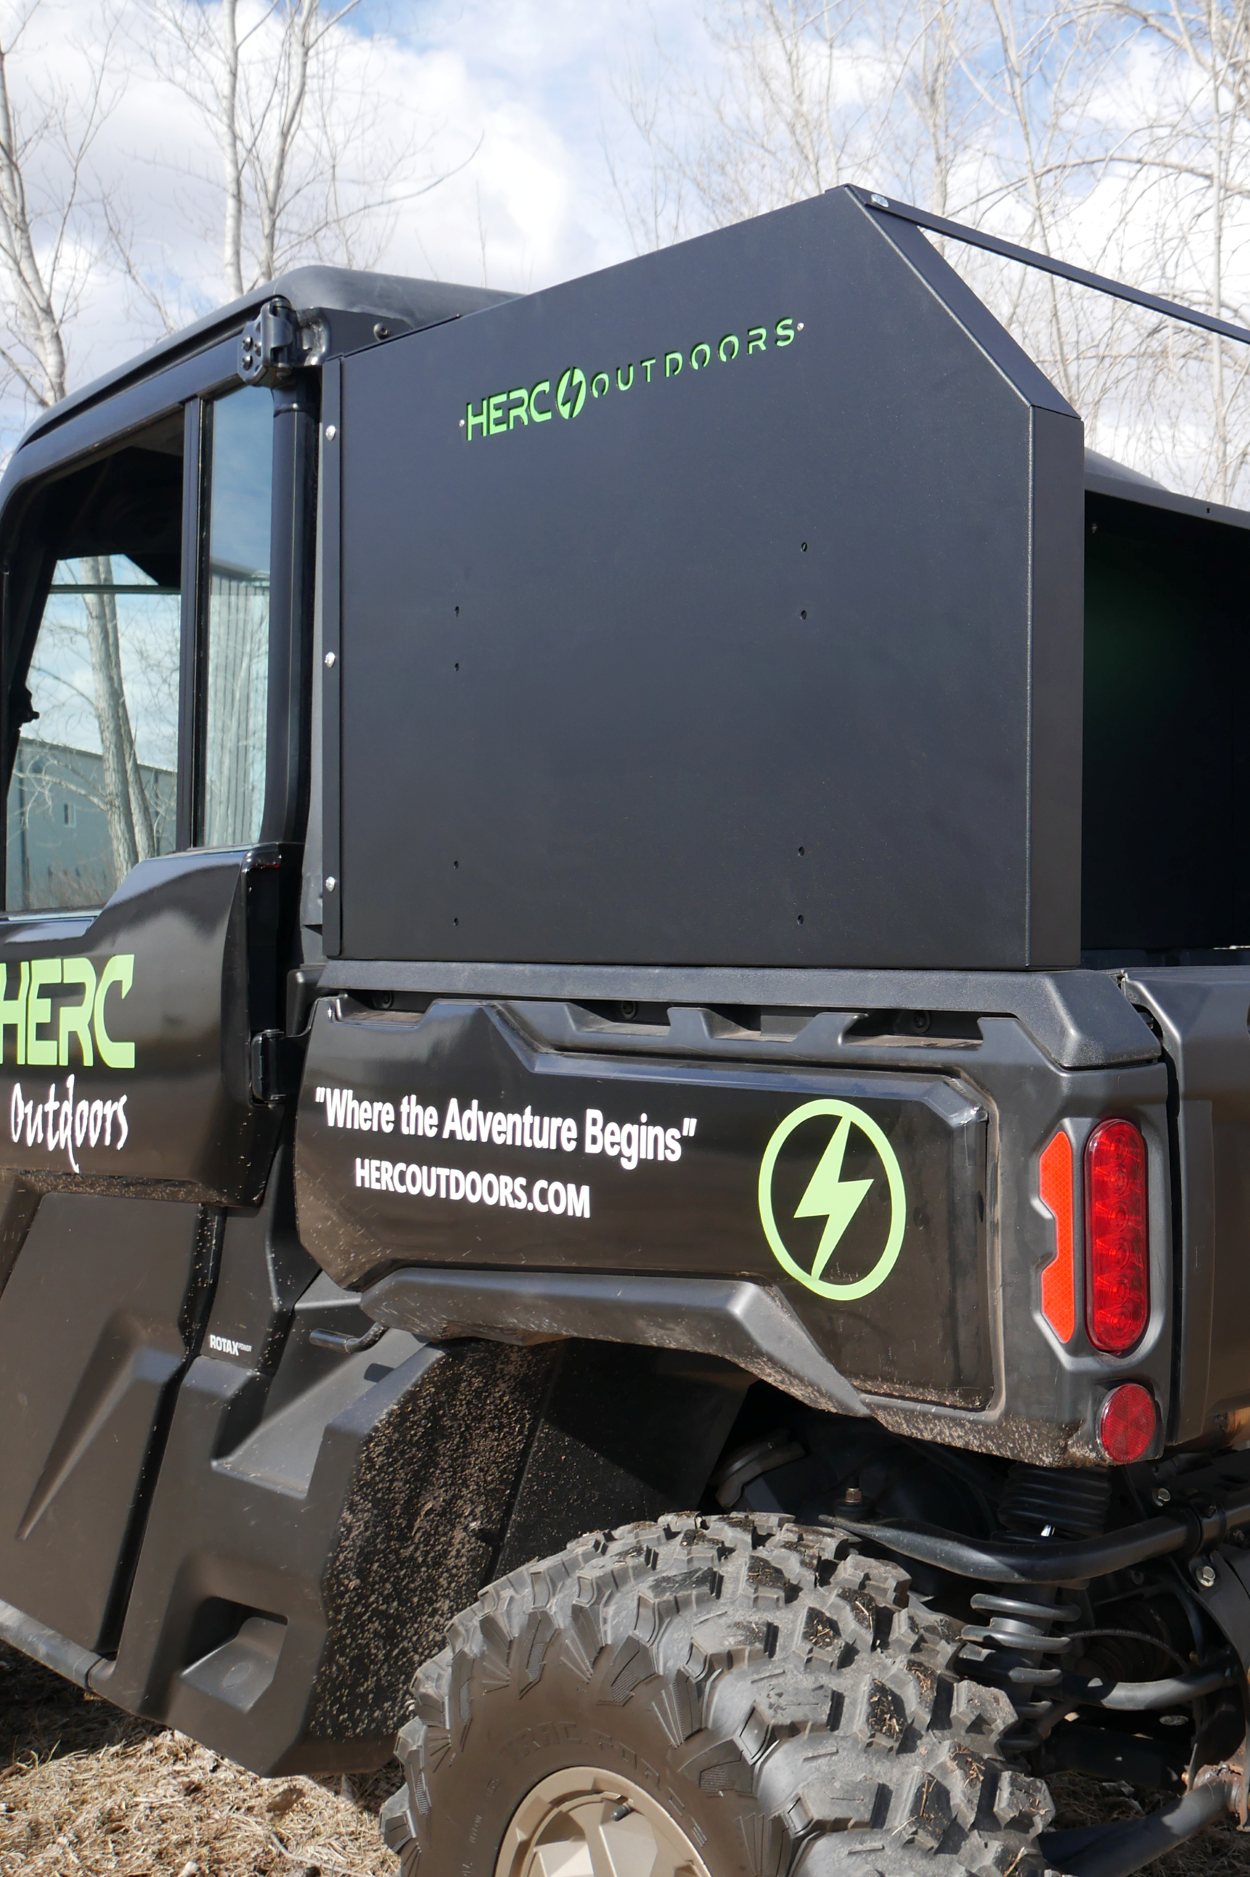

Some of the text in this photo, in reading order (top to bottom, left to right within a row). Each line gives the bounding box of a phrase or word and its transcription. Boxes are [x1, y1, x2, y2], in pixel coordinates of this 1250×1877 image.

[465, 317, 796, 442] HERC OUTDOORS
[0, 954, 136, 1069] HERC
[10, 1073, 129, 1174] Outdoors
[315, 1086, 698, 1171] "Where the Adventure Begins"
[354, 1157, 591, 1219] HERCOUTDOORS.COM
[209, 1334, 240, 1357] ROTAX
